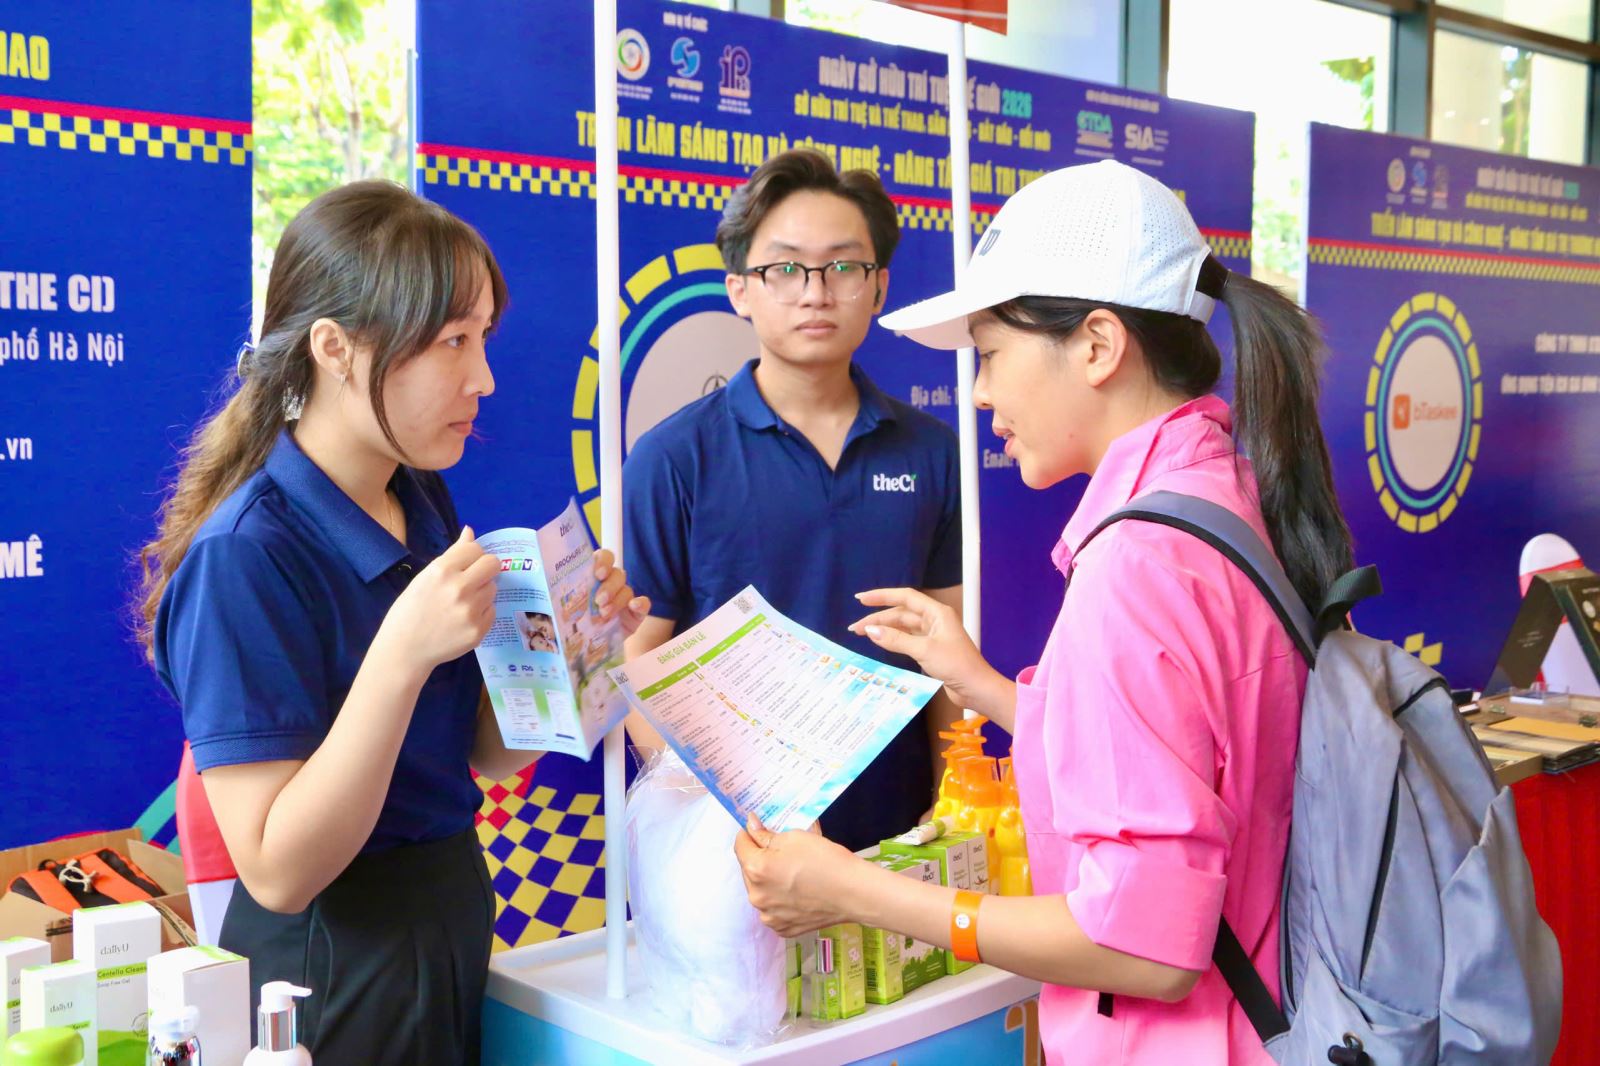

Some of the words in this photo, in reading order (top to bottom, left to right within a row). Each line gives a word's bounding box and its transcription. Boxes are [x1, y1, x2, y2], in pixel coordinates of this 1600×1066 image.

[1002, 88, 1032, 119] 2026
[637, 114, 675, 157] LÃM
[680, 121, 728, 164] SÁNG
[732, 132, 764, 174] TẠO
[894, 149, 934, 188] NÂNG
[970, 160, 993, 195] GIÁ
[0, 271, 58, 311] THE
[0, 327, 39, 366] phố
[49, 331, 79, 361] Hà
[88, 331, 124, 367] Nội
[501, 559, 533, 571] HTV
